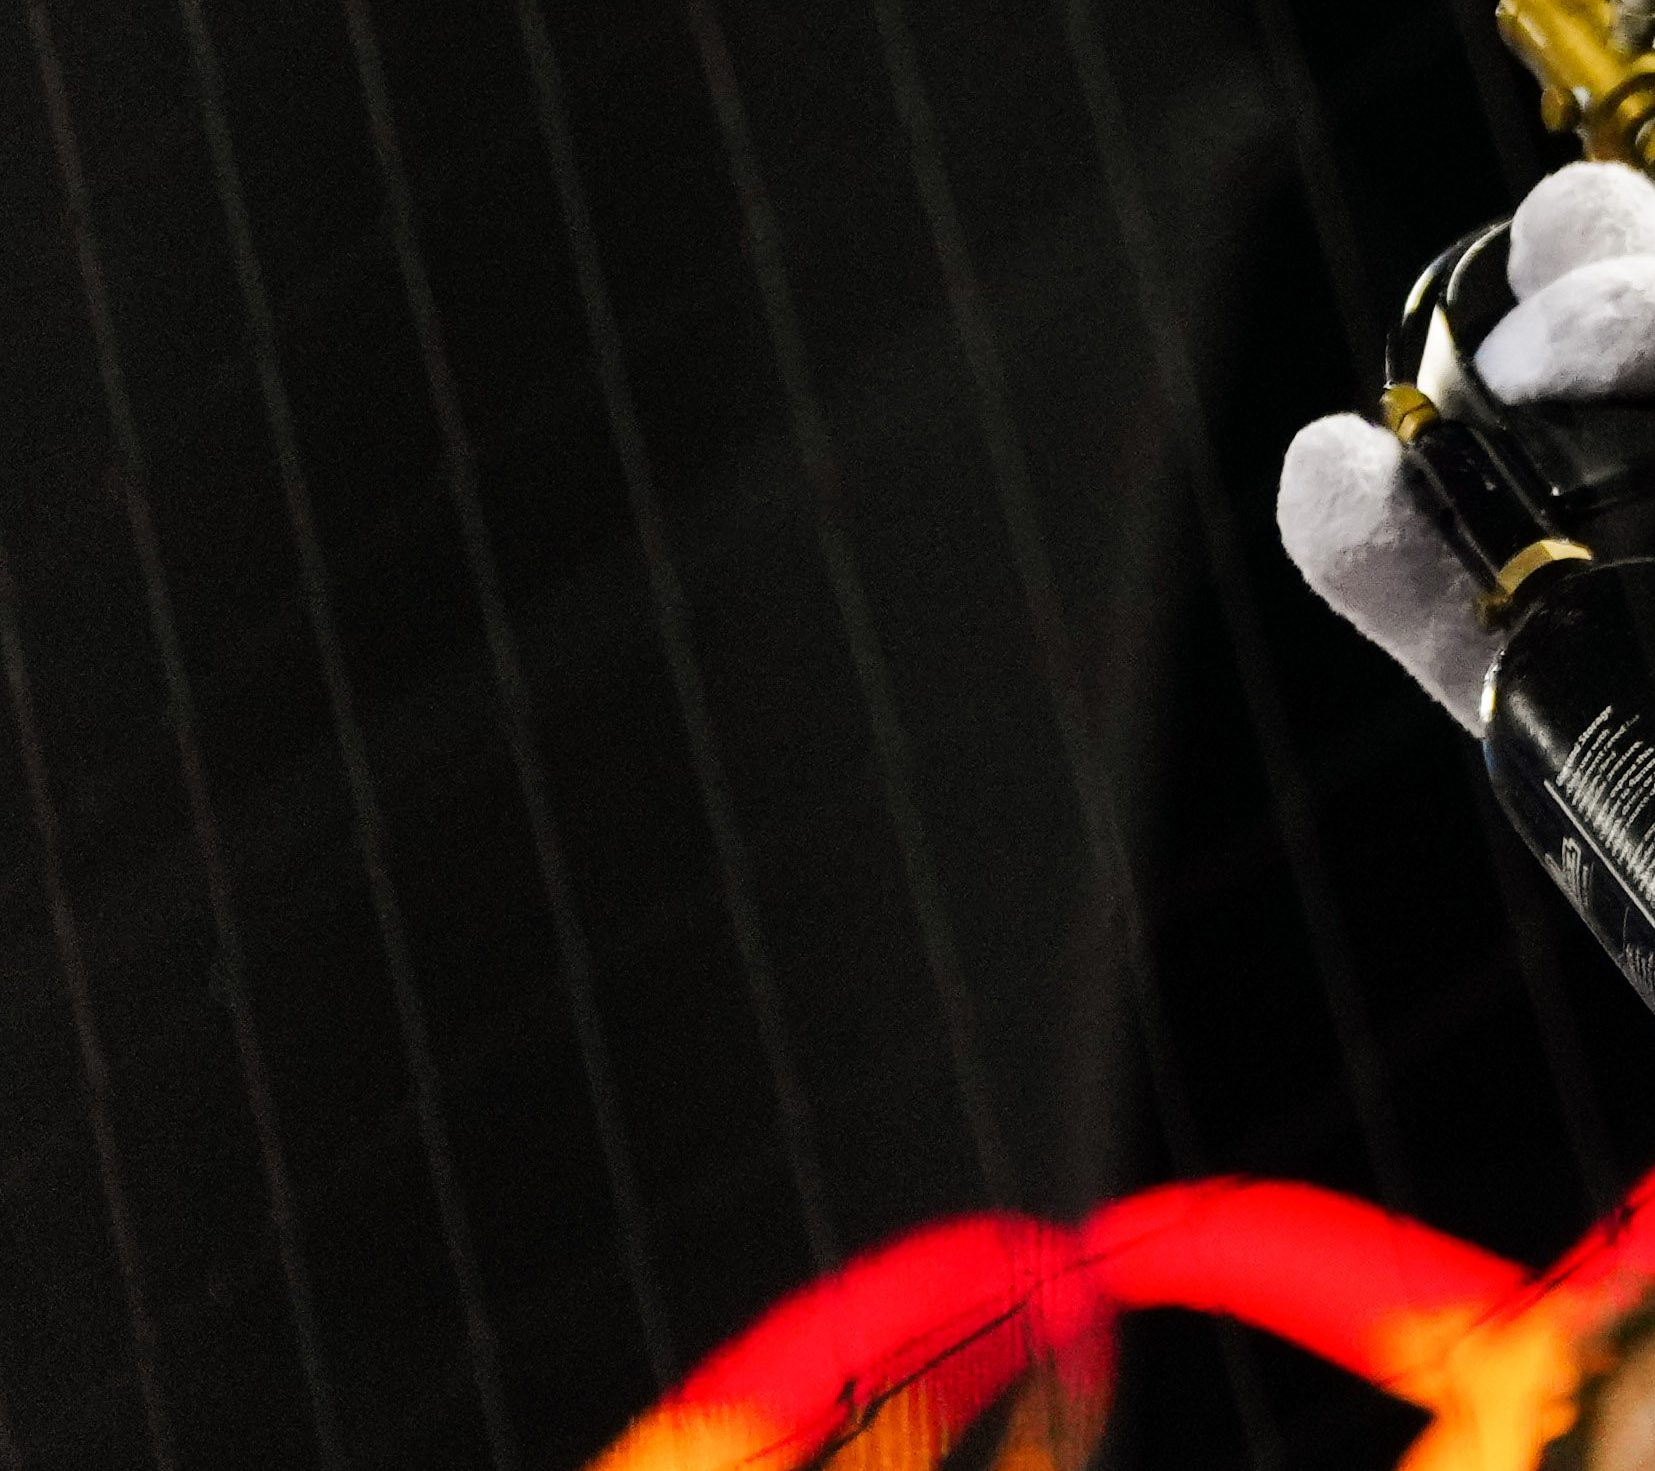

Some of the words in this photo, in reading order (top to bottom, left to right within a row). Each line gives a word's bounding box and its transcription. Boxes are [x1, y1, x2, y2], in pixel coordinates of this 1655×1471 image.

[1577, 704, 1613, 745] Storage
[1590, 728, 1610, 750] with
[1635, 746, 1654, 764] this
